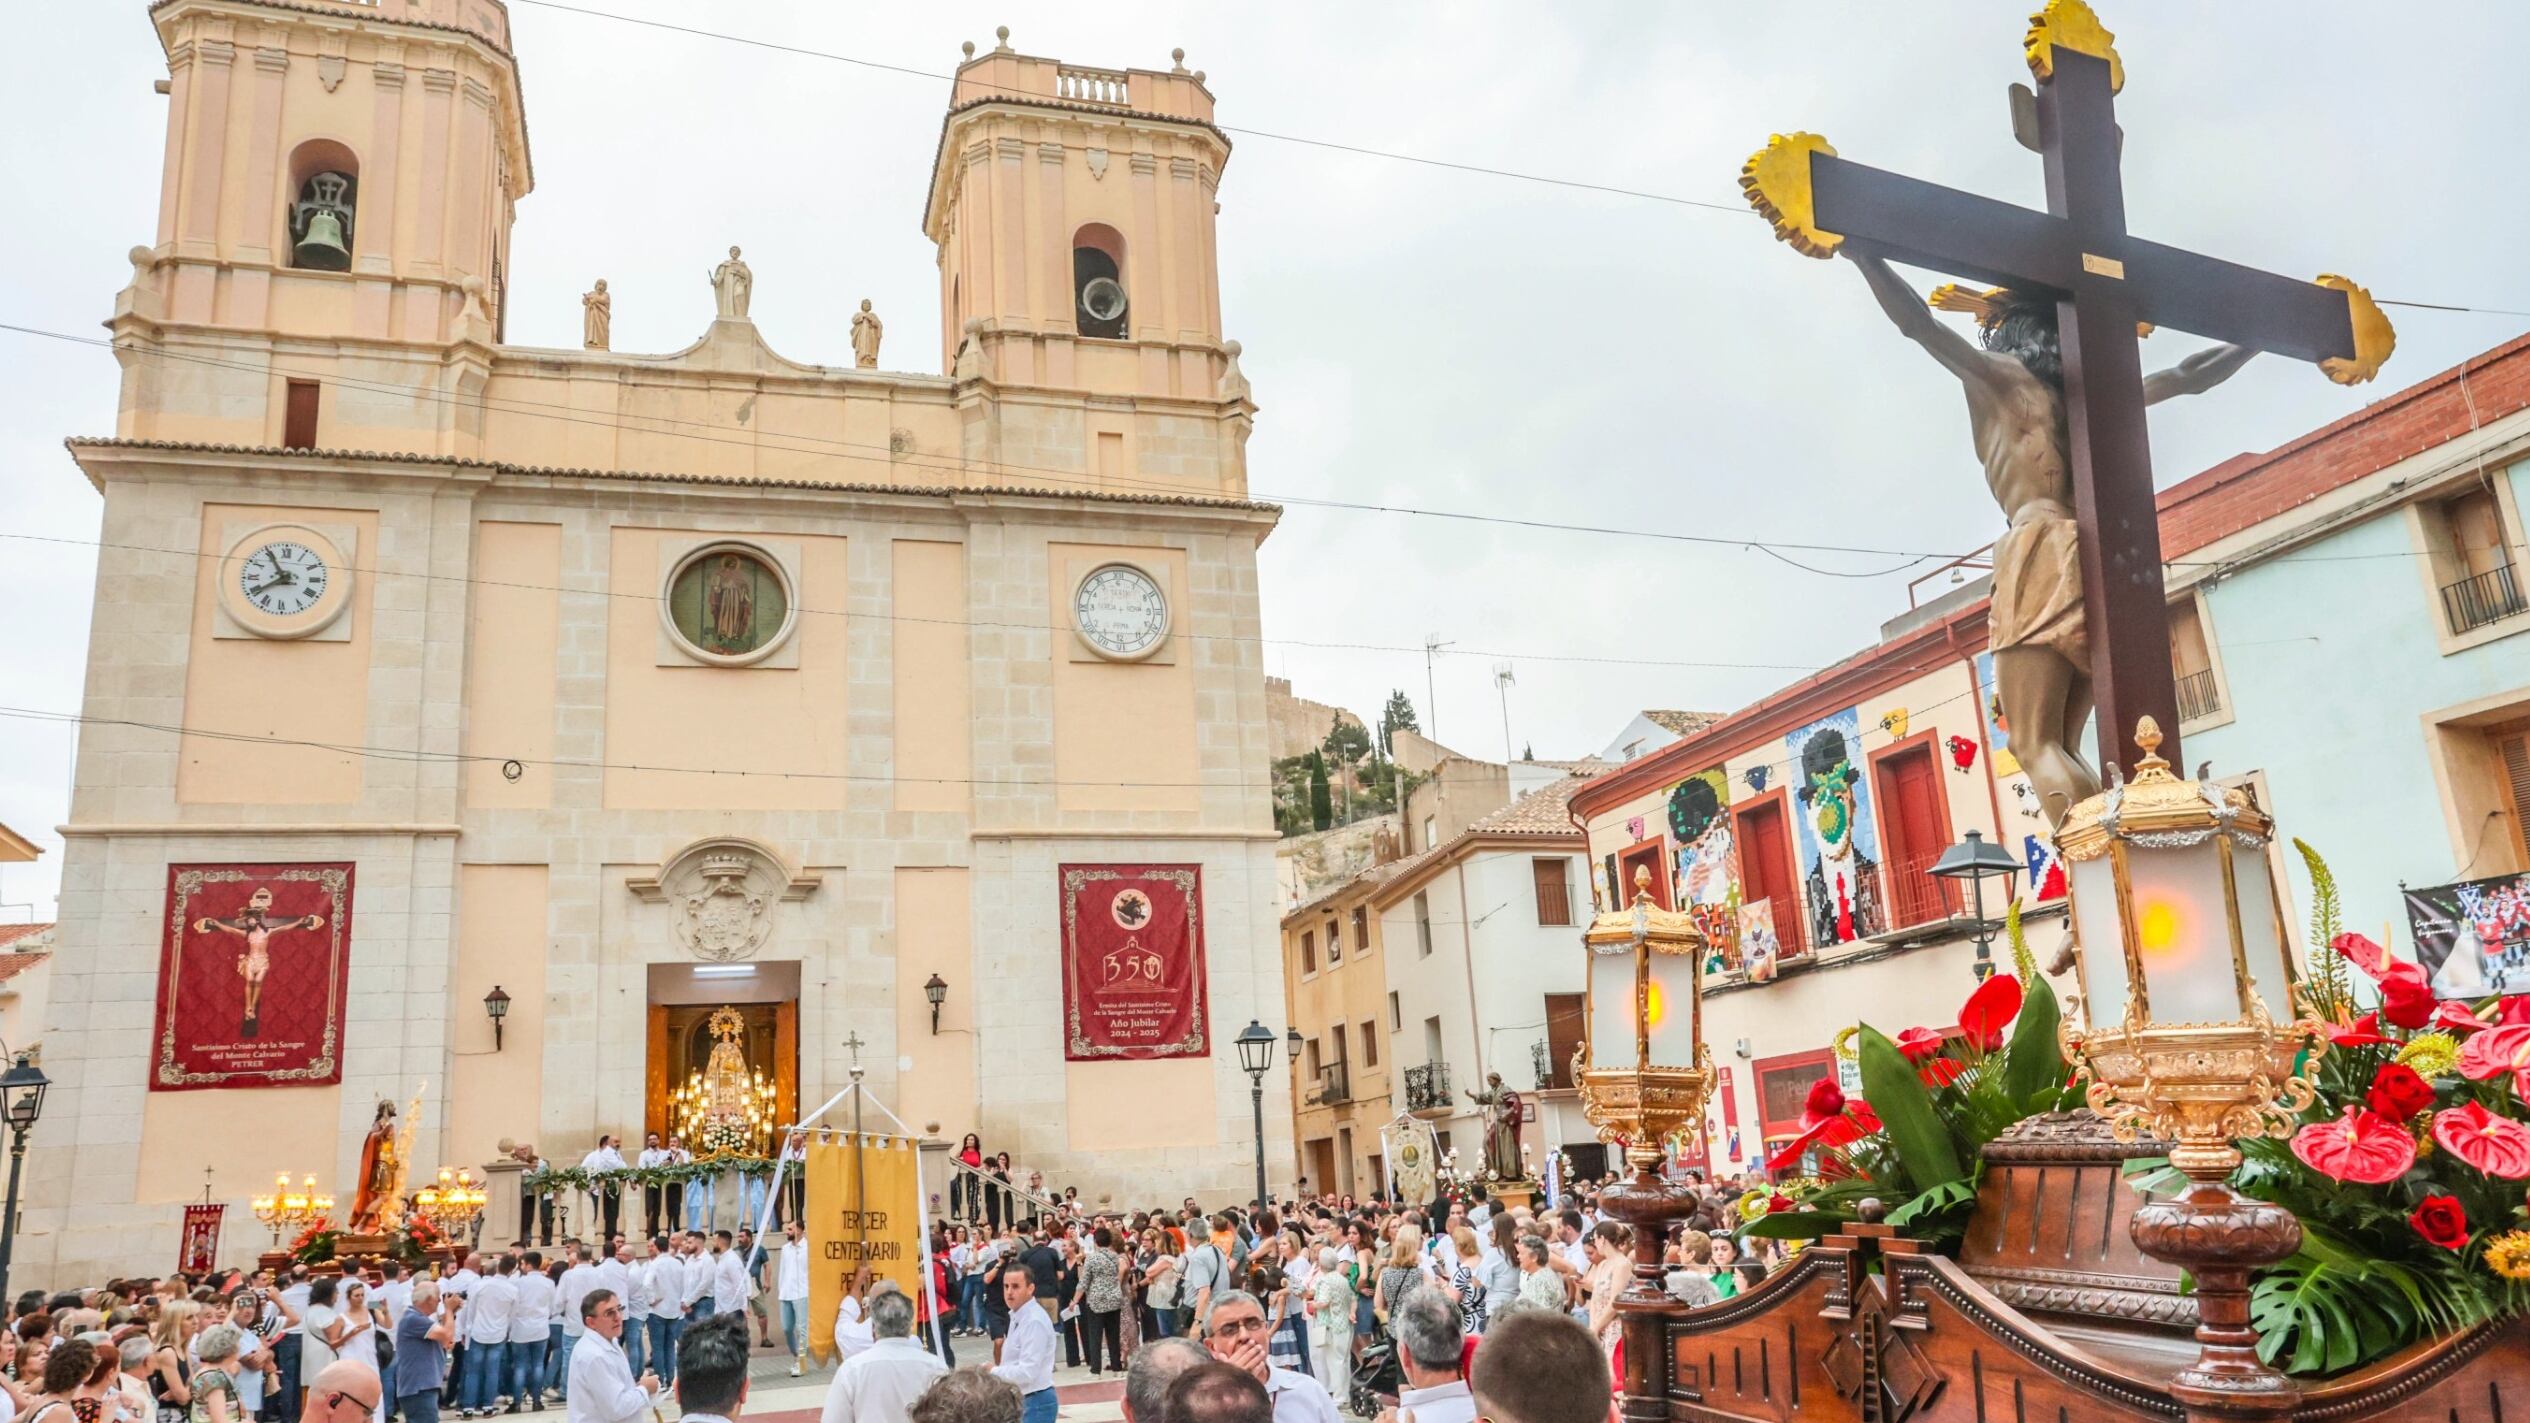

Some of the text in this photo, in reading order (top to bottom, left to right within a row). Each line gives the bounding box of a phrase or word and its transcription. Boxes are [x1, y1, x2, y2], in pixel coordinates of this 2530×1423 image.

[1110, 1018, 1160, 1029] Año Jubilar
[1110, 1029, 1131, 1038] 2024
[1139, 1029, 1160, 1038] 2025
[232, 1042, 257, 1050] Cristo
[258, 1041, 268, 1049] de
[269, 1041, 278, 1049] la
[279, 1040, 306, 1050] Sangre
[210, 1050, 286, 1060] del Monte Calvario
[231, 1060, 264, 1068] PETRER
